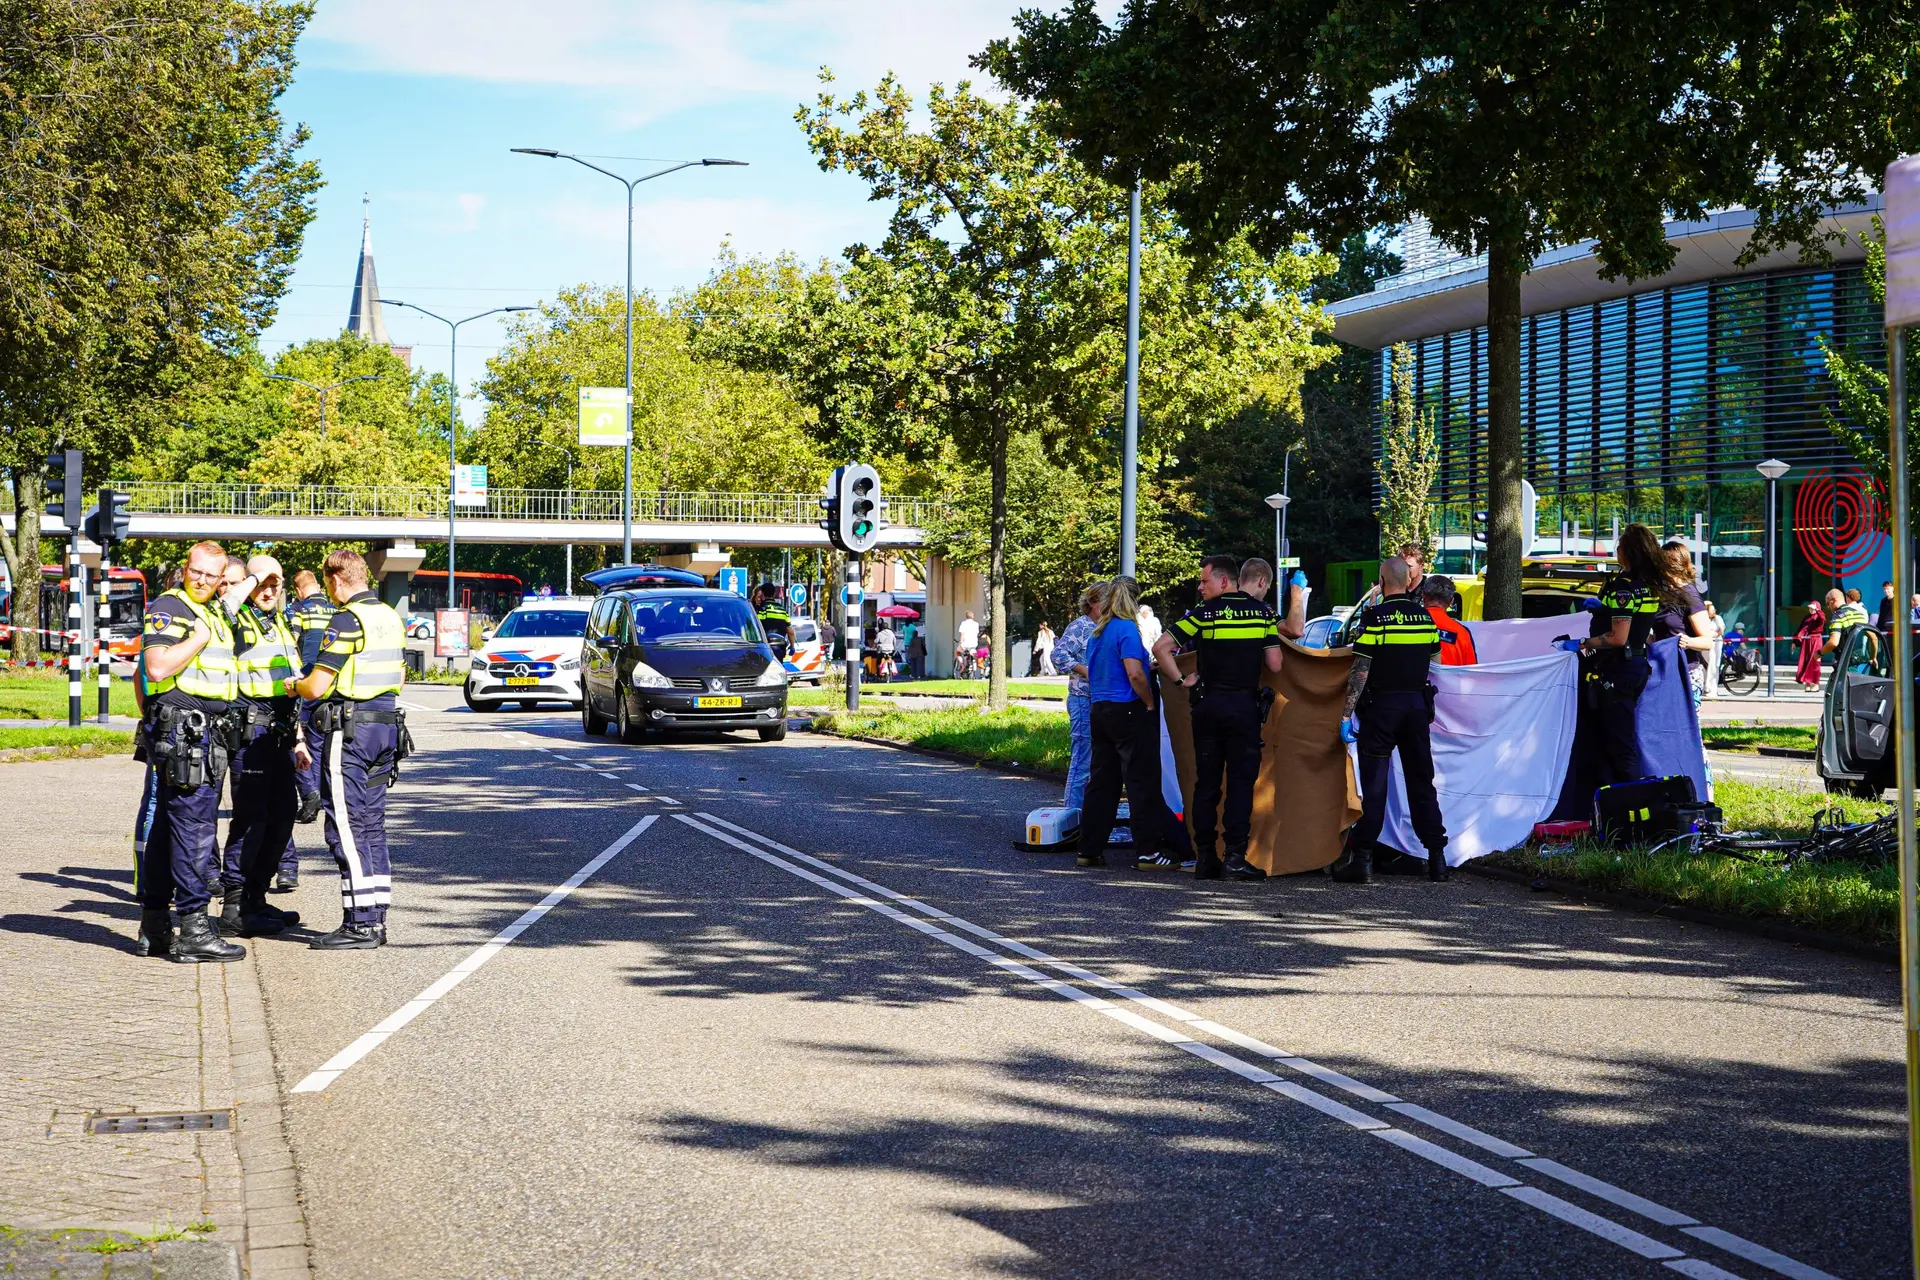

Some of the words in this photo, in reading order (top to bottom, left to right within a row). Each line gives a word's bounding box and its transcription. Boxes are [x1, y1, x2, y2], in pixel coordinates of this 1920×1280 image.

[1219, 606, 1260, 619] POLITIE
[1390, 611, 1428, 623] POLITIE
[701, 697, 738, 707] 44-ZR-RJ
